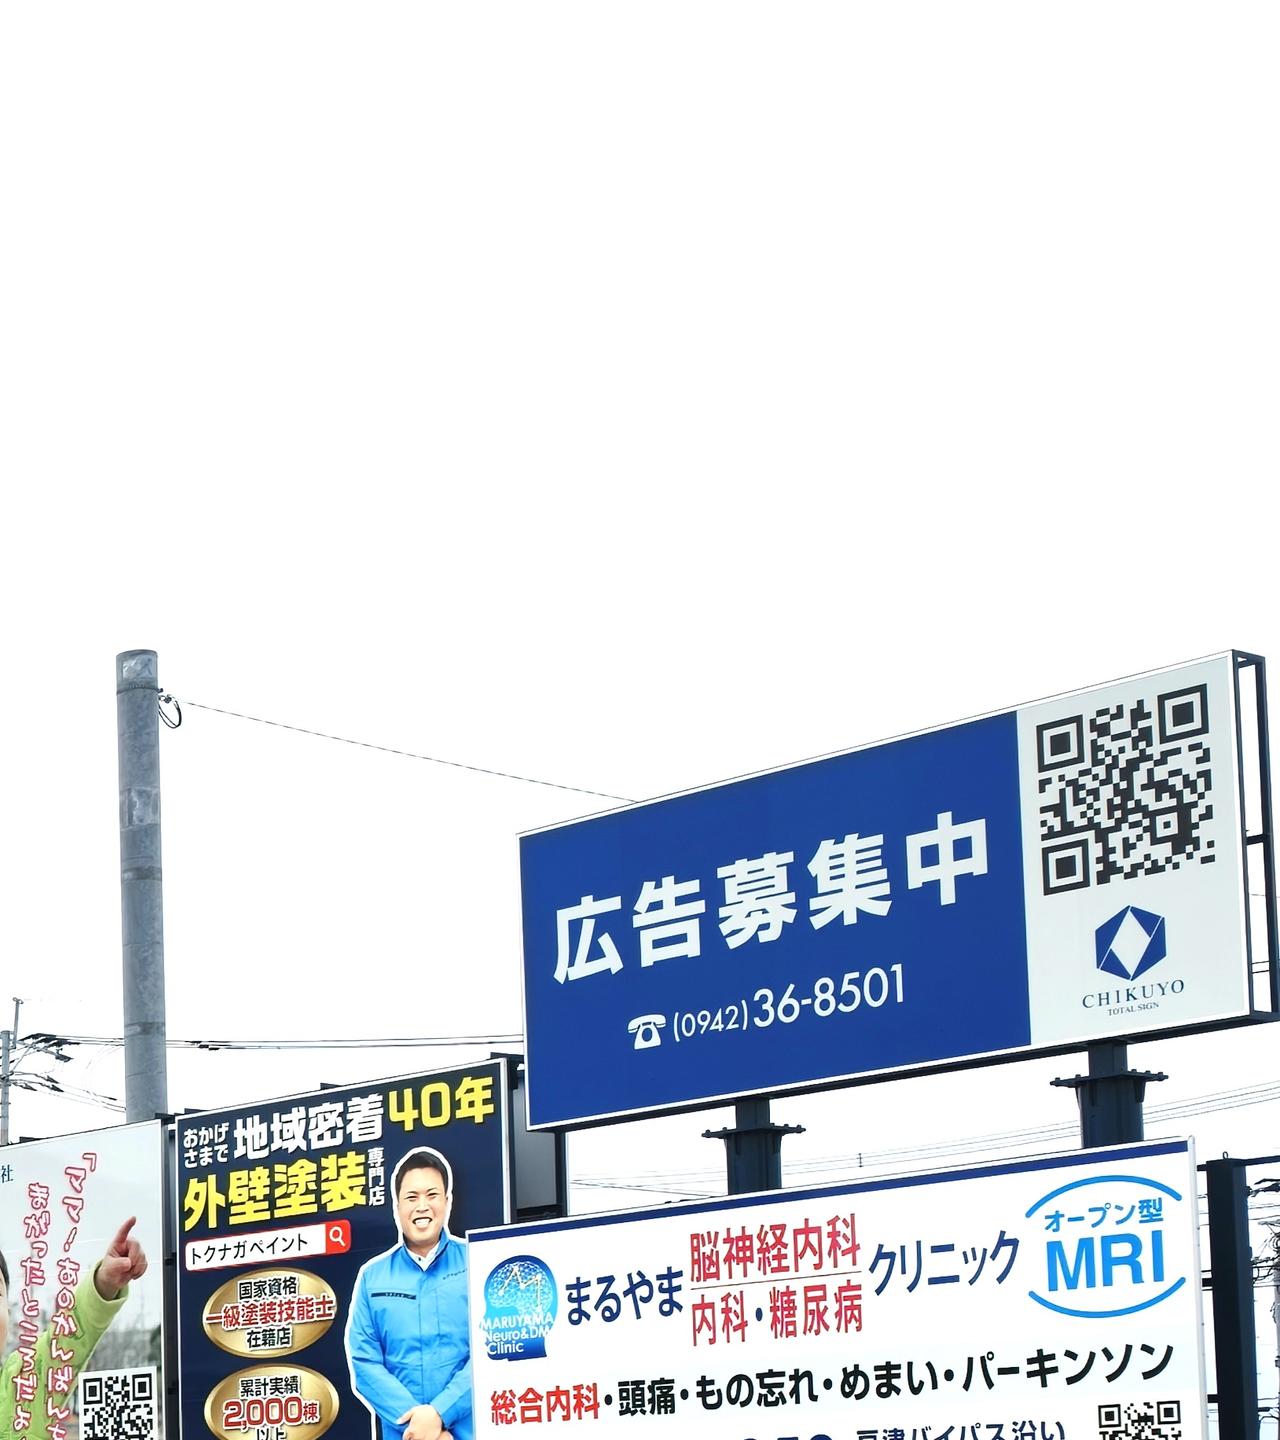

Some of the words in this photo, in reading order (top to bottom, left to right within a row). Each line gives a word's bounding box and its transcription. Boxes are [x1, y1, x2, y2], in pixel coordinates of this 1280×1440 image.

[553, 811, 990, 985] 広告募集中
[1082, 979, 1185, 1009] CHIKUYO
[1106, 1005, 1136, 1016] TOTAL
[1137, 1001, 1160, 1011] SIGN
[183, 1122, 230, 1148] おかげ
[183, 1143, 229, 1169] さまで
[184, 1150, 368, 1233] 外壁塗装
[368, 1147, 385, 1207] 専門店
[1044, 1199, 1164, 1233] オープン型
[191, 1232, 308, 1266] トクナガペイント
[690, 1213, 861, 1283] 脳神経内科
[869, 1230, 1020, 1296] クリニック
[1046, 1233, 1166, 1293] MRI
[239, 1276, 298, 1300] 国家資格
[565, 1265, 684, 1327] まるやま
[205, 1294, 334, 1328] 一級塗装技能士
[246, 1327, 292, 1349] 在籍店
[487, 1340, 525, 1355] Clinic
[240, 1375, 300, 1398] 累計実績
